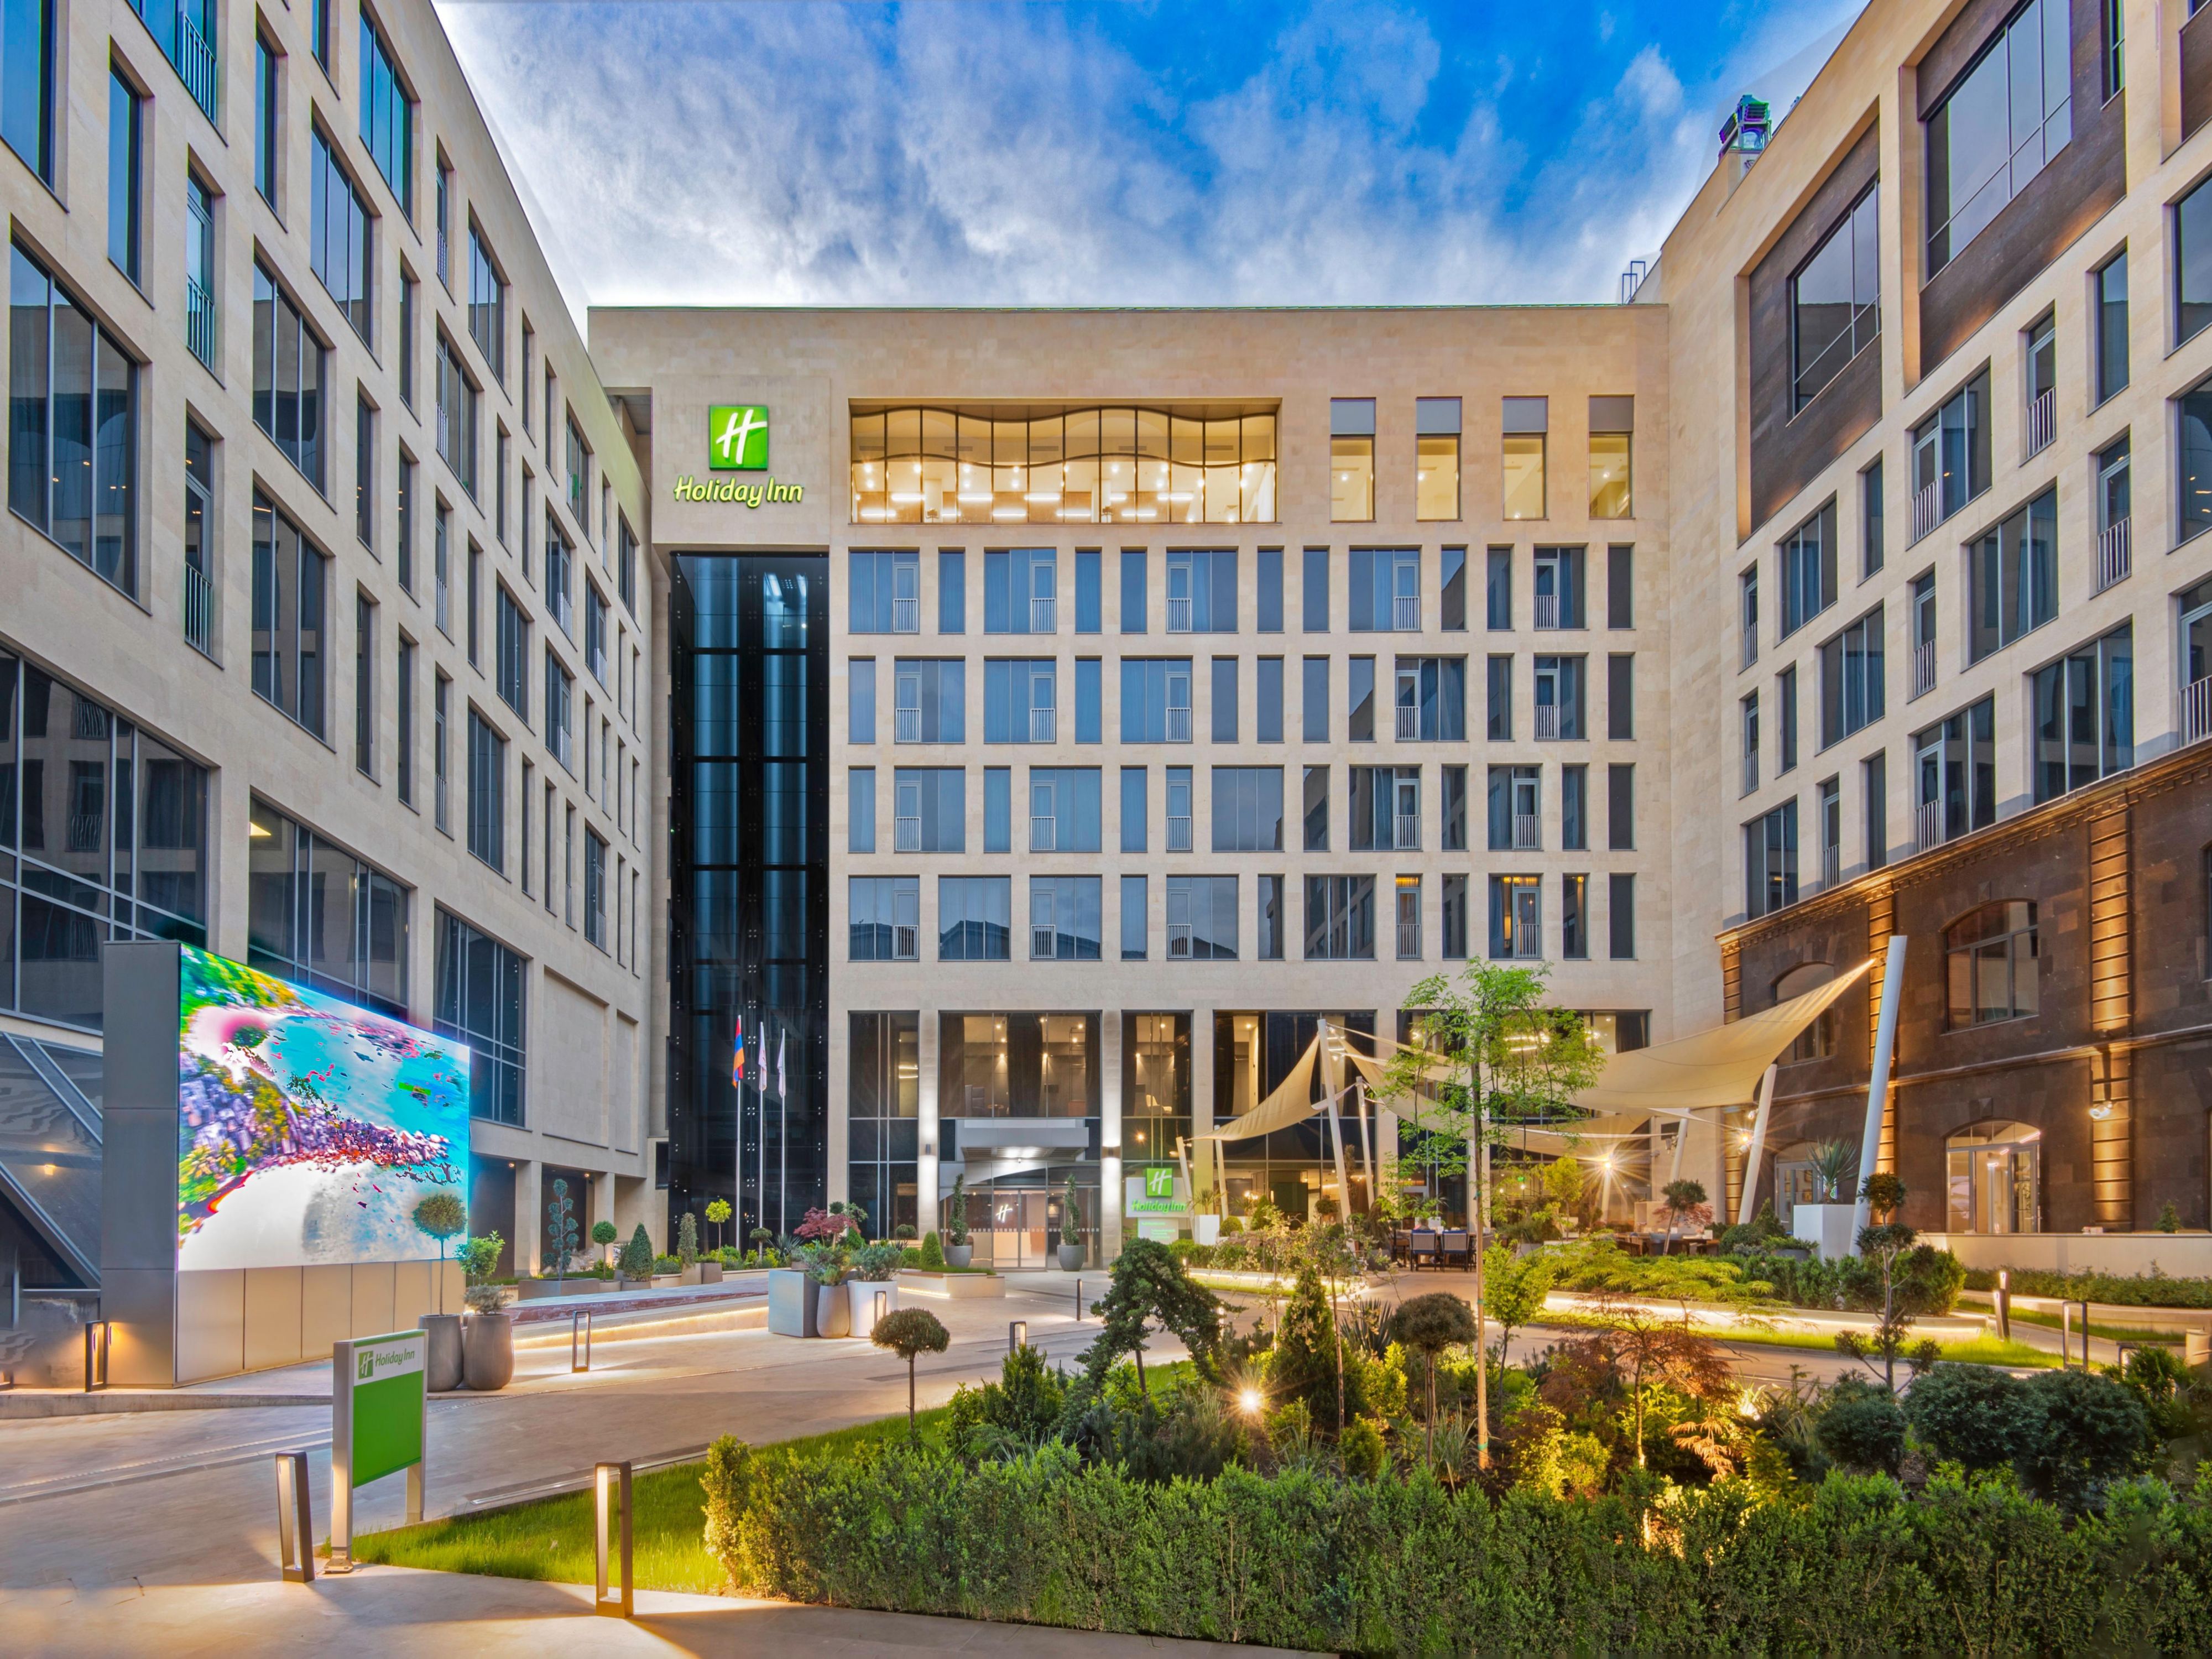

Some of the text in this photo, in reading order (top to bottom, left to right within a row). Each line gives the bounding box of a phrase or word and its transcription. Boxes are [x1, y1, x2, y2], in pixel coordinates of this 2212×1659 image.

[716, 409, 767, 465] H
[674, 476, 803, 508] Holiday Inn
[1149, 1170, 1172, 1194] H
[1131, 1199, 1186, 1213] Holiday Inn
[375, 1348, 415, 1367] Holiday Inn
